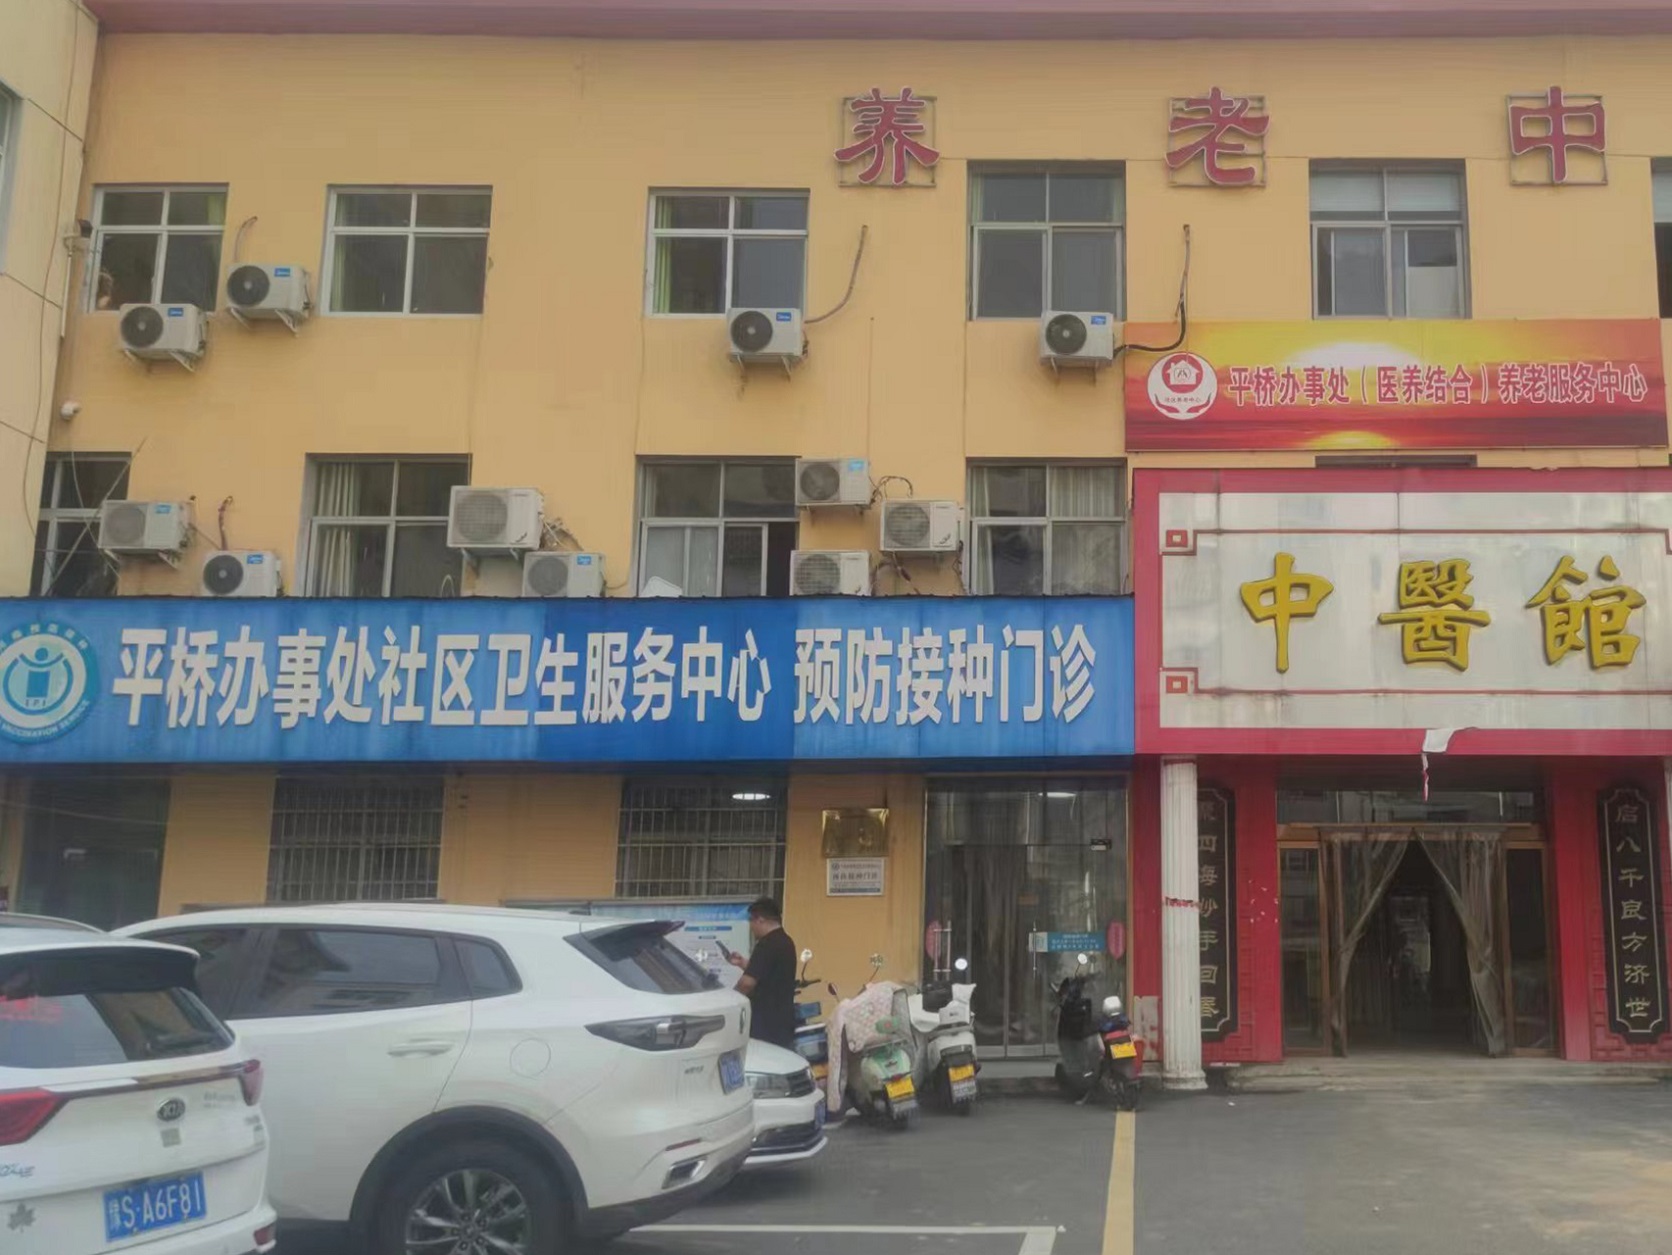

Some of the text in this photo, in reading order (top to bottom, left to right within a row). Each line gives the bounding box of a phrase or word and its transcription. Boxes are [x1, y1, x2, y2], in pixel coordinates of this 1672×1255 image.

[1229, 362, 1649, 408] 平桥办事处（医养结合）养老服务中心
[113, 624, 1097, 729] 平桥办事处社区卫生服务中心 预防接种门诊
